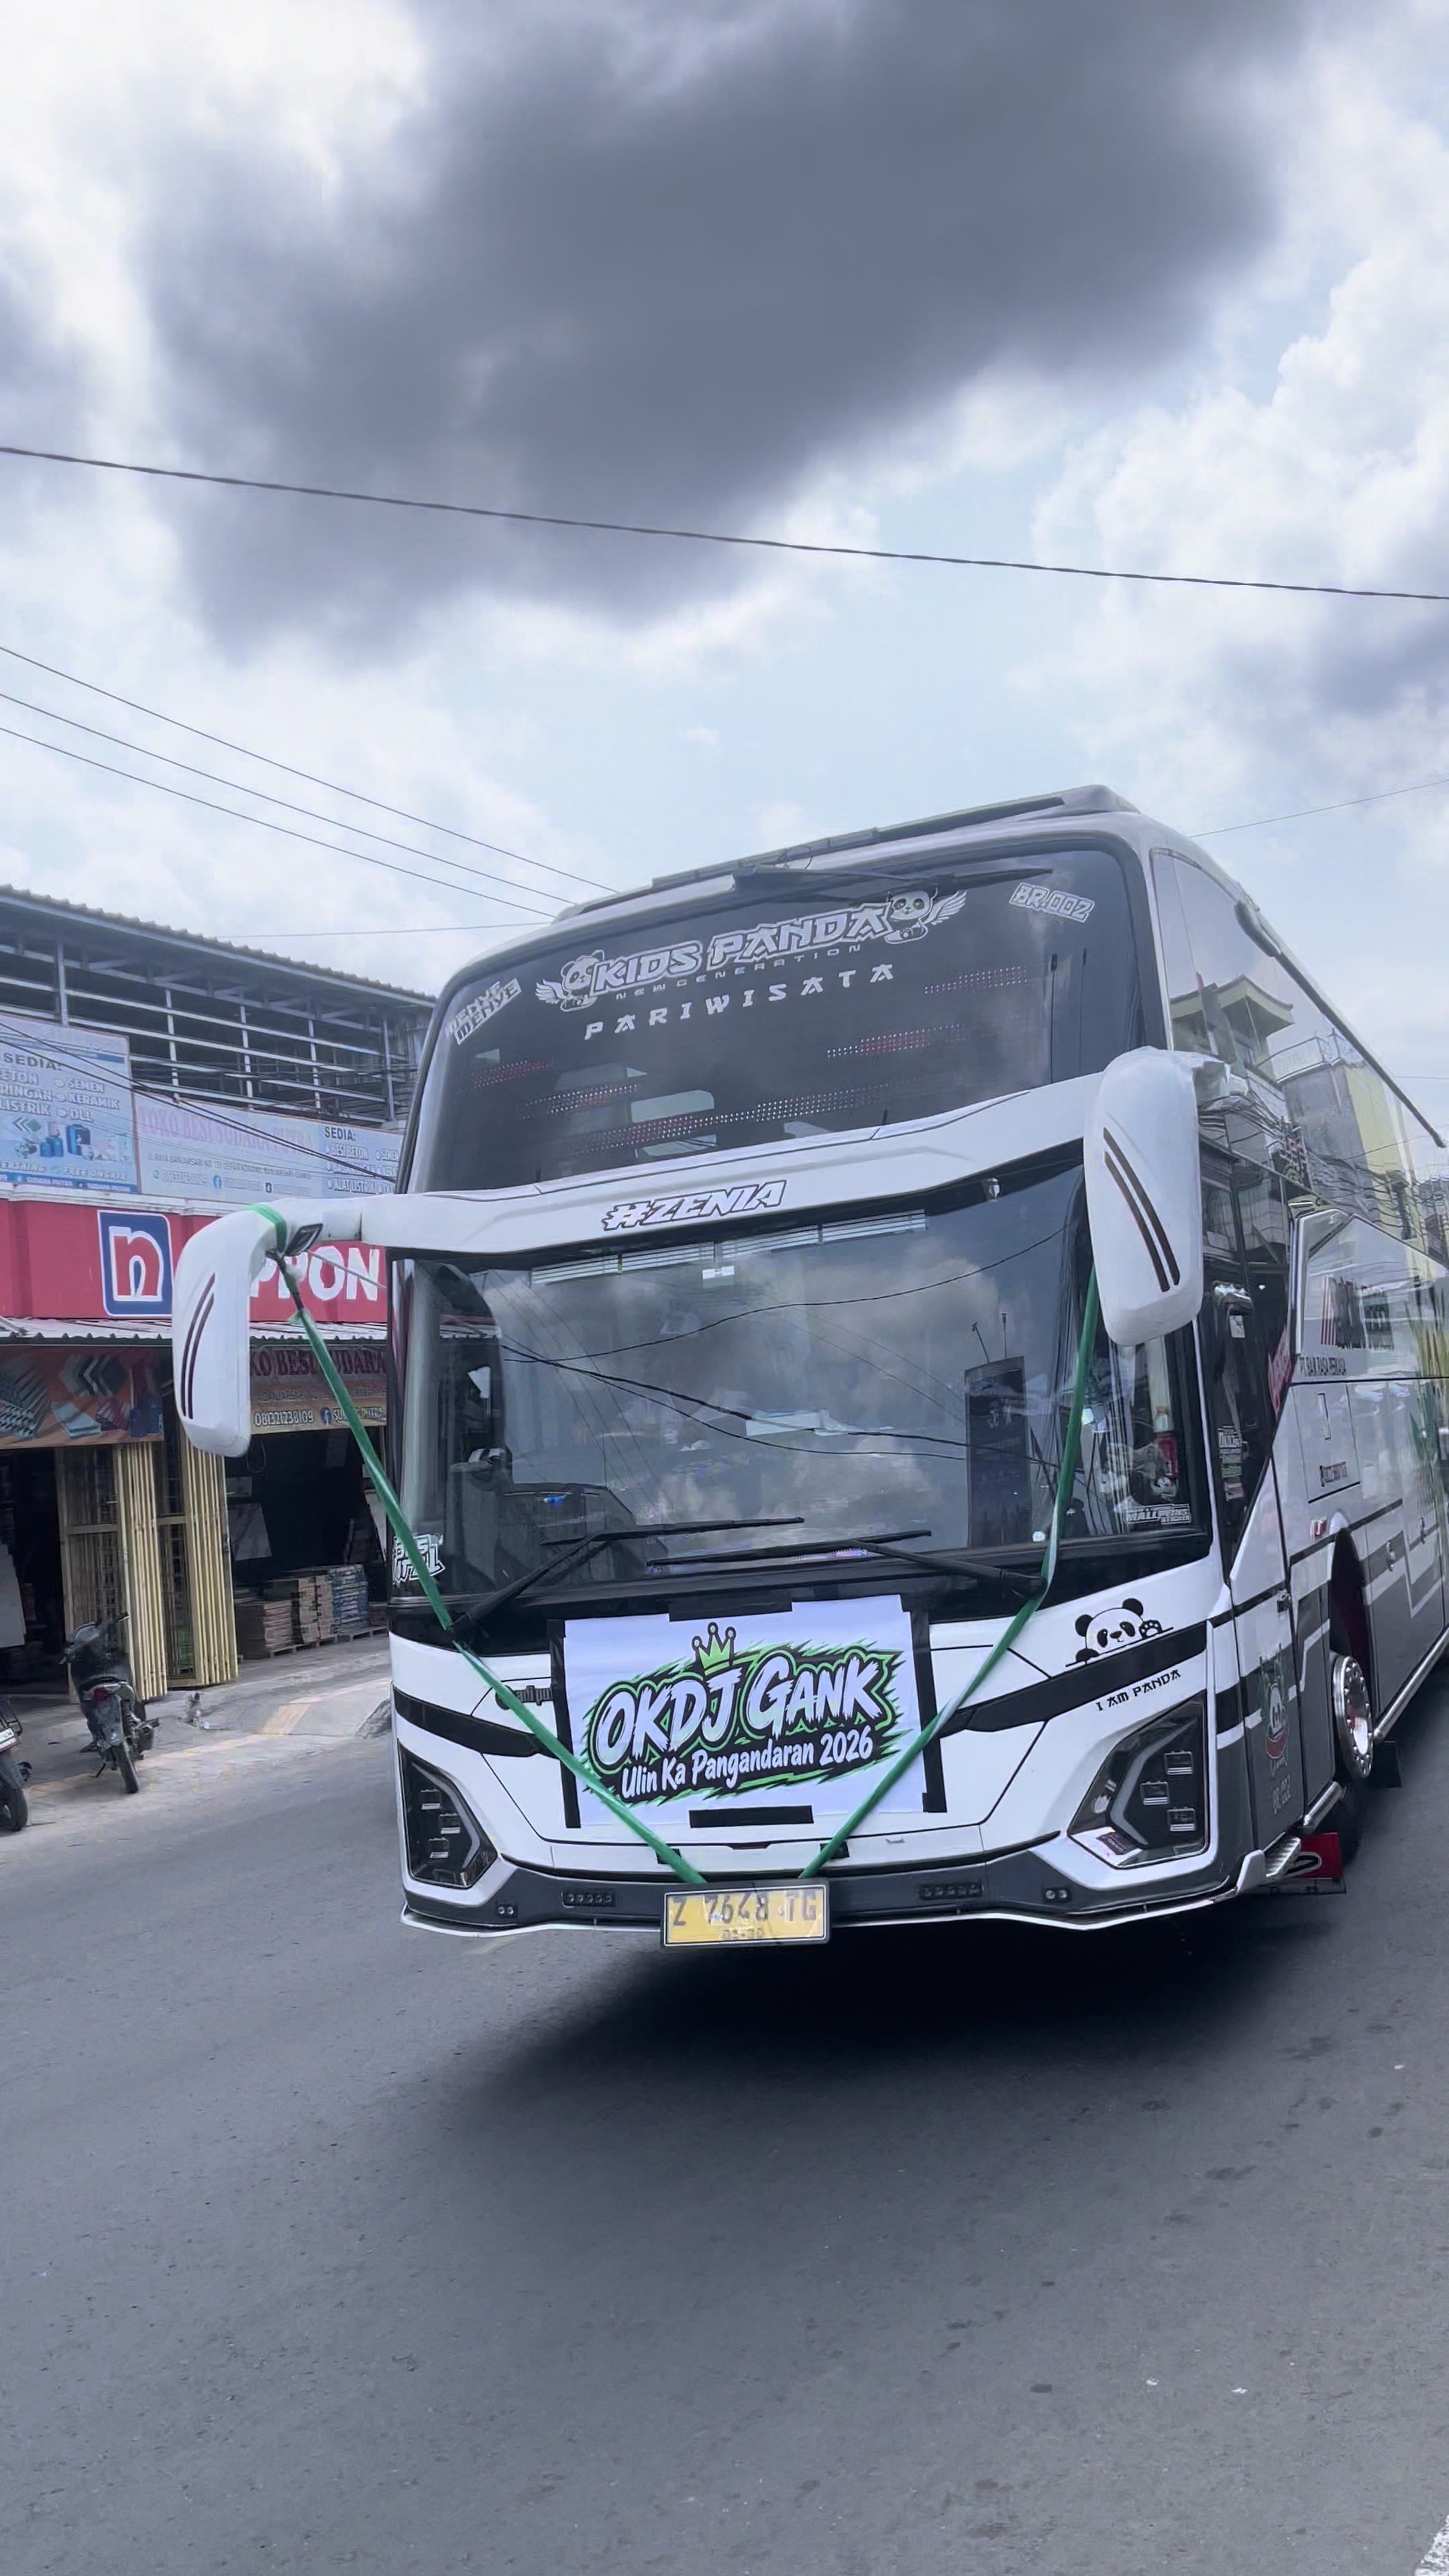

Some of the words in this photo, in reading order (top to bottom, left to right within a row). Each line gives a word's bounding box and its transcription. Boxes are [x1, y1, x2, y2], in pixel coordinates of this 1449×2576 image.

[592, 942, 702, 994] KIDS
[708, 904, 890, 967] PANDA
[676, 943, 861, 987] GENERATION
[584, 964, 894, 1040] PARIWISATA
[3, 1052, 62, 1071] SEDIA:
[68, 1078, 105, 1094] SEMEN
[68, 1093, 120, 1110] KERAMIK
[0, 1098, 51, 1116] LISTRIK
[70, 1108, 93, 1122] DLL
[324, 1126, 356, 1141] SEDIA:
[64, 1165, 87, 1177] FREE
[602, 1180, 787, 1230] #ZENIA
[250, 1245, 380, 1301] PPON
[596, 1666, 743, 1766] OKDJ
[747, 1655, 882, 1739] GANK
[1095, 1701, 1104, 1711] I
[1107, 1691, 1129, 1707] AM
[1132, 1669, 1181, 1697] PANDA
[621, 1766, 657, 1799] Ulin
[661, 1756, 686, 1792] Ka
[692, 1738, 814, 1790] Pangandaran
[819, 1725, 873, 1766] 2026
